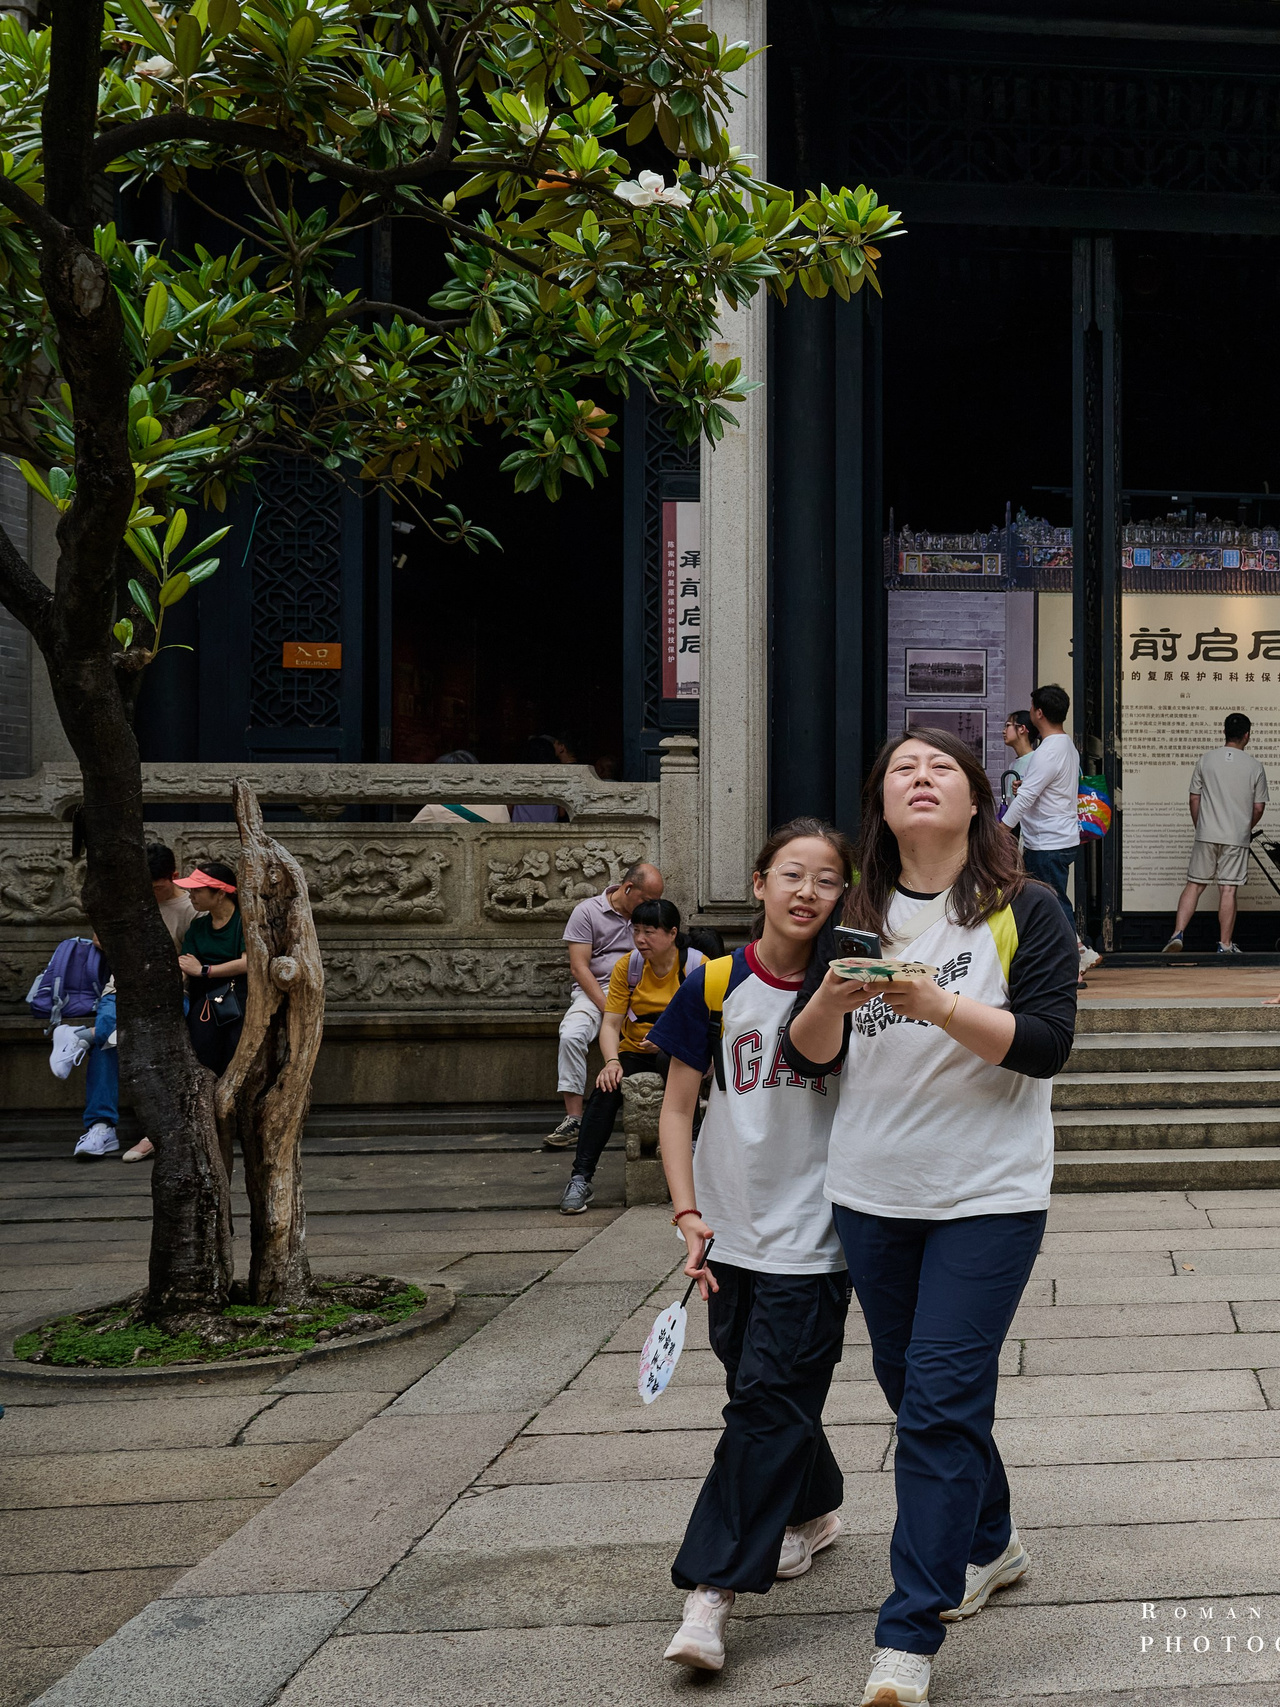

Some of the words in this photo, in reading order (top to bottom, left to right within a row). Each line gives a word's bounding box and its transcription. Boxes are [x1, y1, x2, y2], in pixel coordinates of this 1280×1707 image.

[667, 541, 676, 663] 陈家祠的复原保护和科技保护
[295, 646, 329, 658] 入口
[295, 659, 330, 667] Entrance
[937, 951, 973, 976] ES
[856, 1023, 878, 1038] WE
